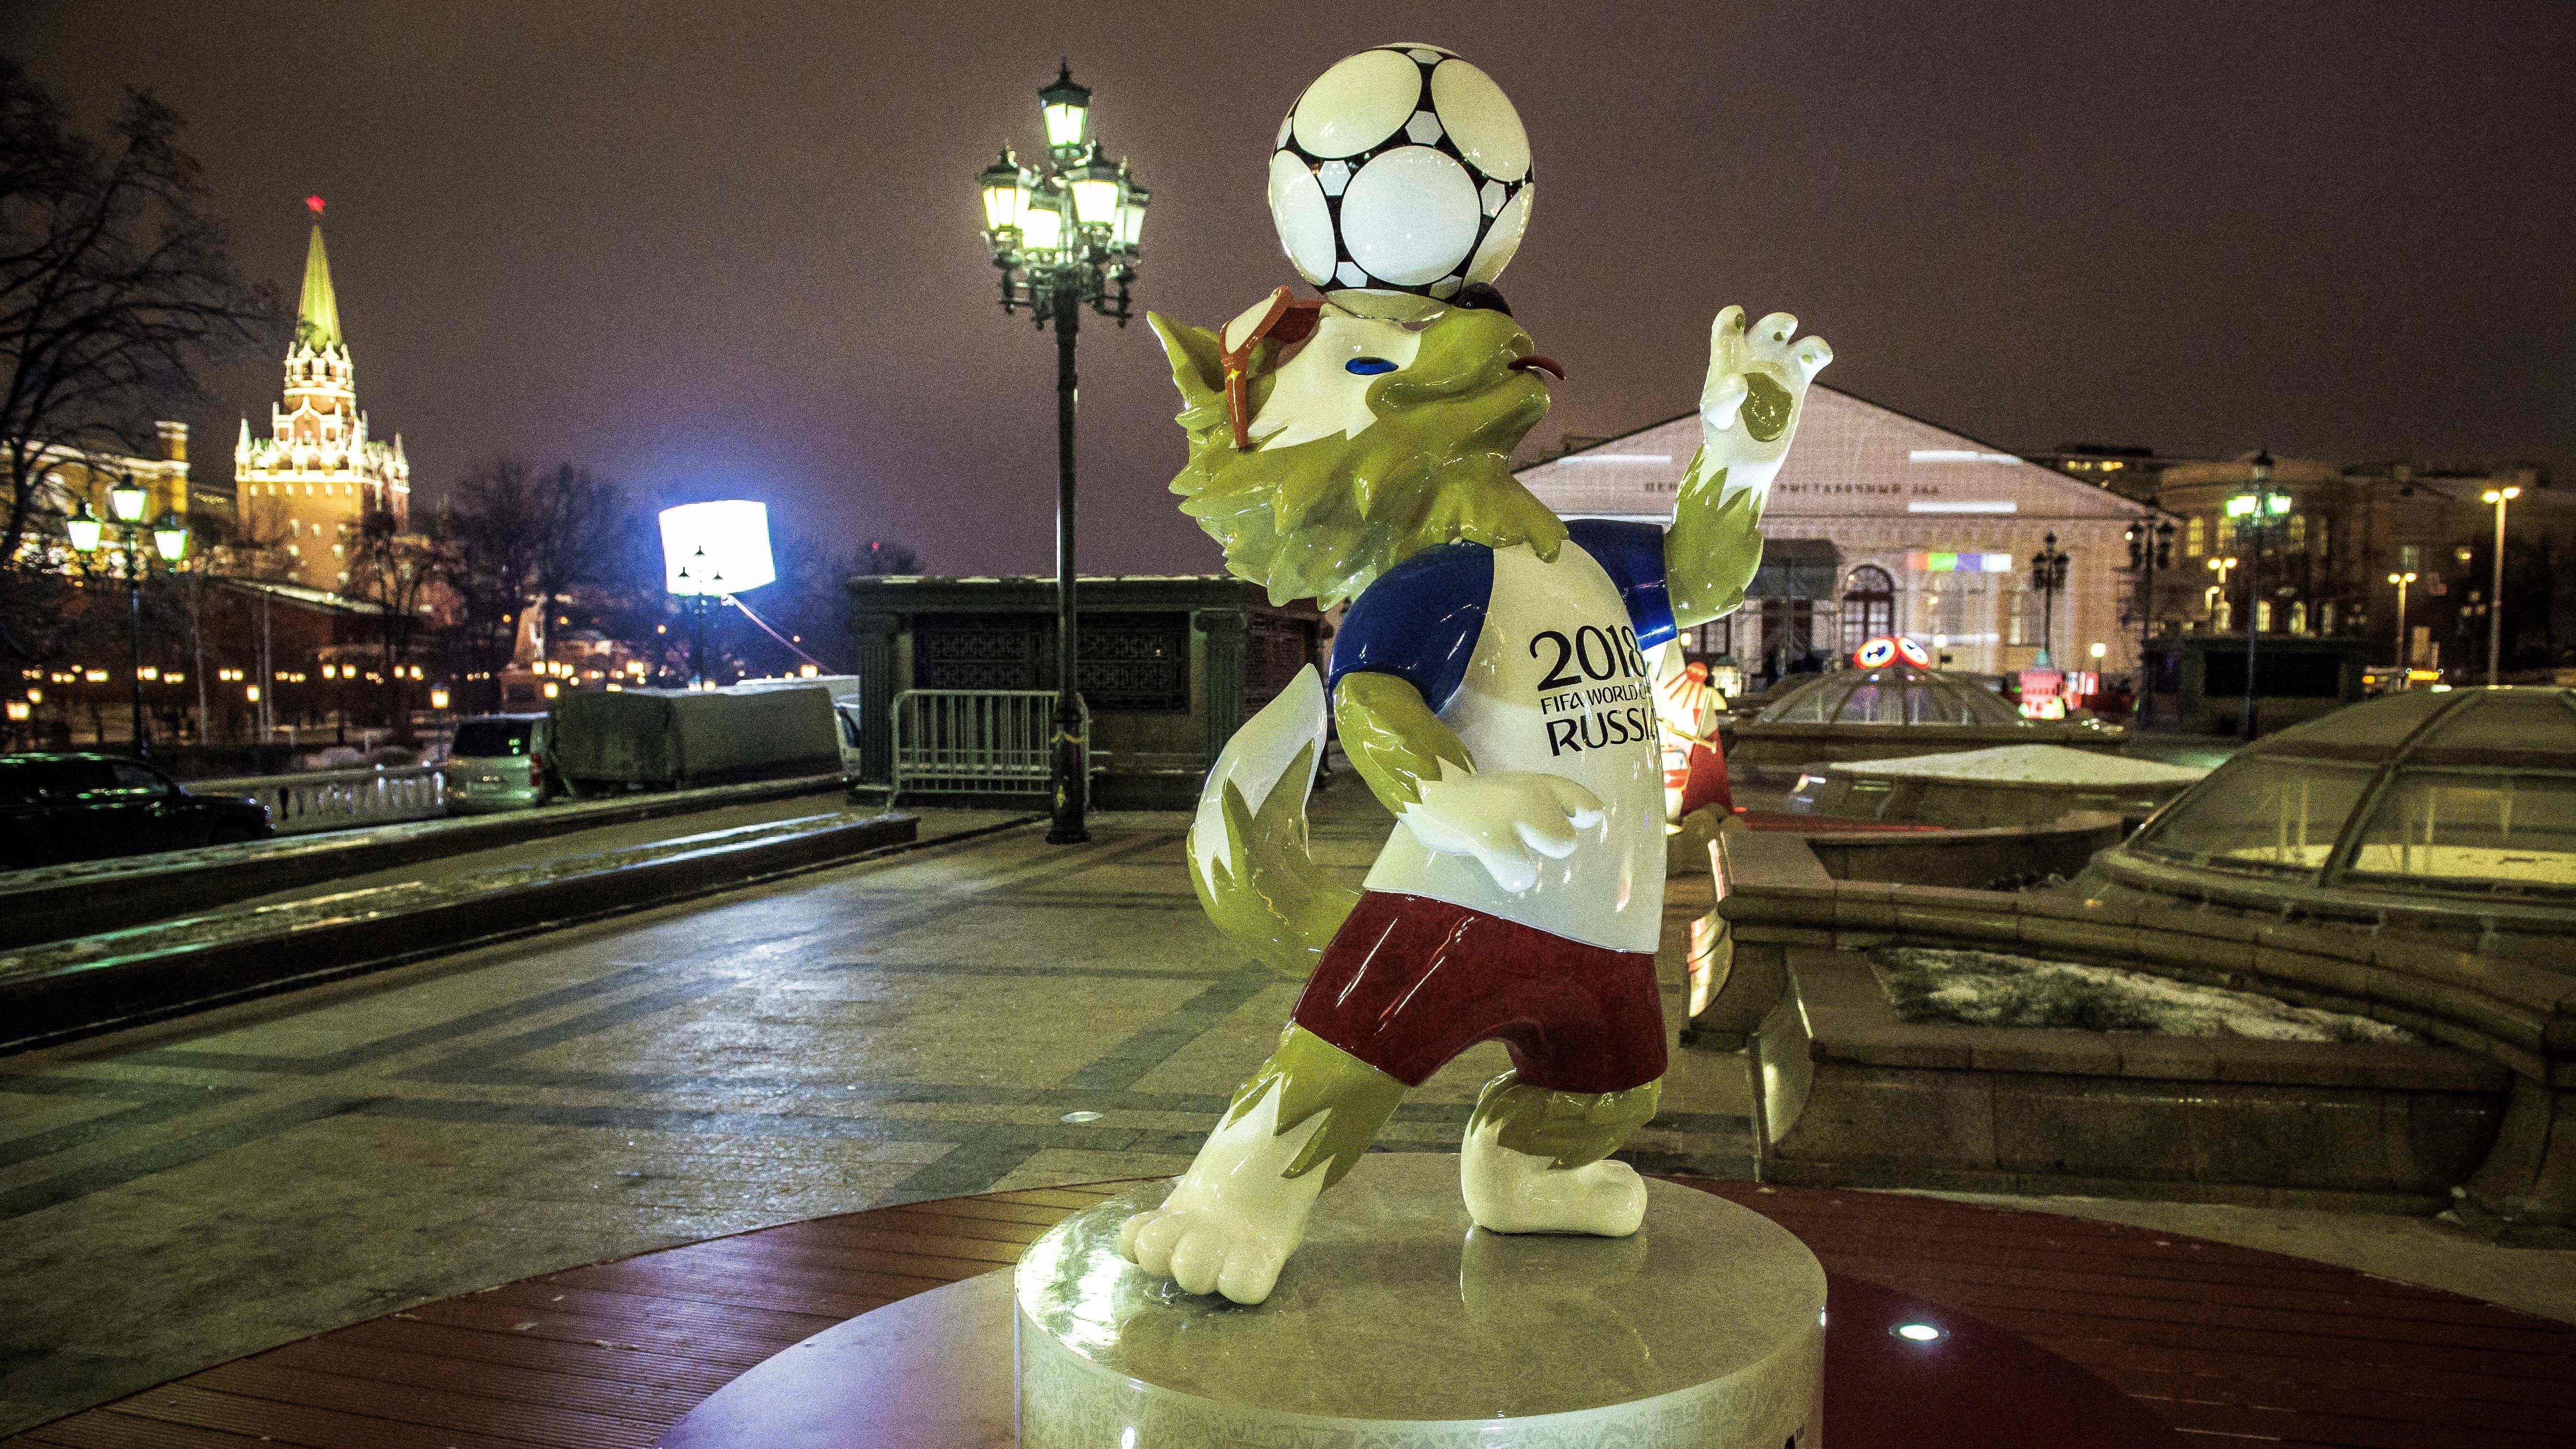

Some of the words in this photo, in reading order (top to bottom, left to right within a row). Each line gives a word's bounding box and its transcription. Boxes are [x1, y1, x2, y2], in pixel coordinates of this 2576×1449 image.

[1529, 624, 1647, 692] 2018
[1540, 692, 1585, 715] FIFA
[1586, 684, 1638, 706] WORLD
[1546, 707, 1658, 757] RUSSIA
